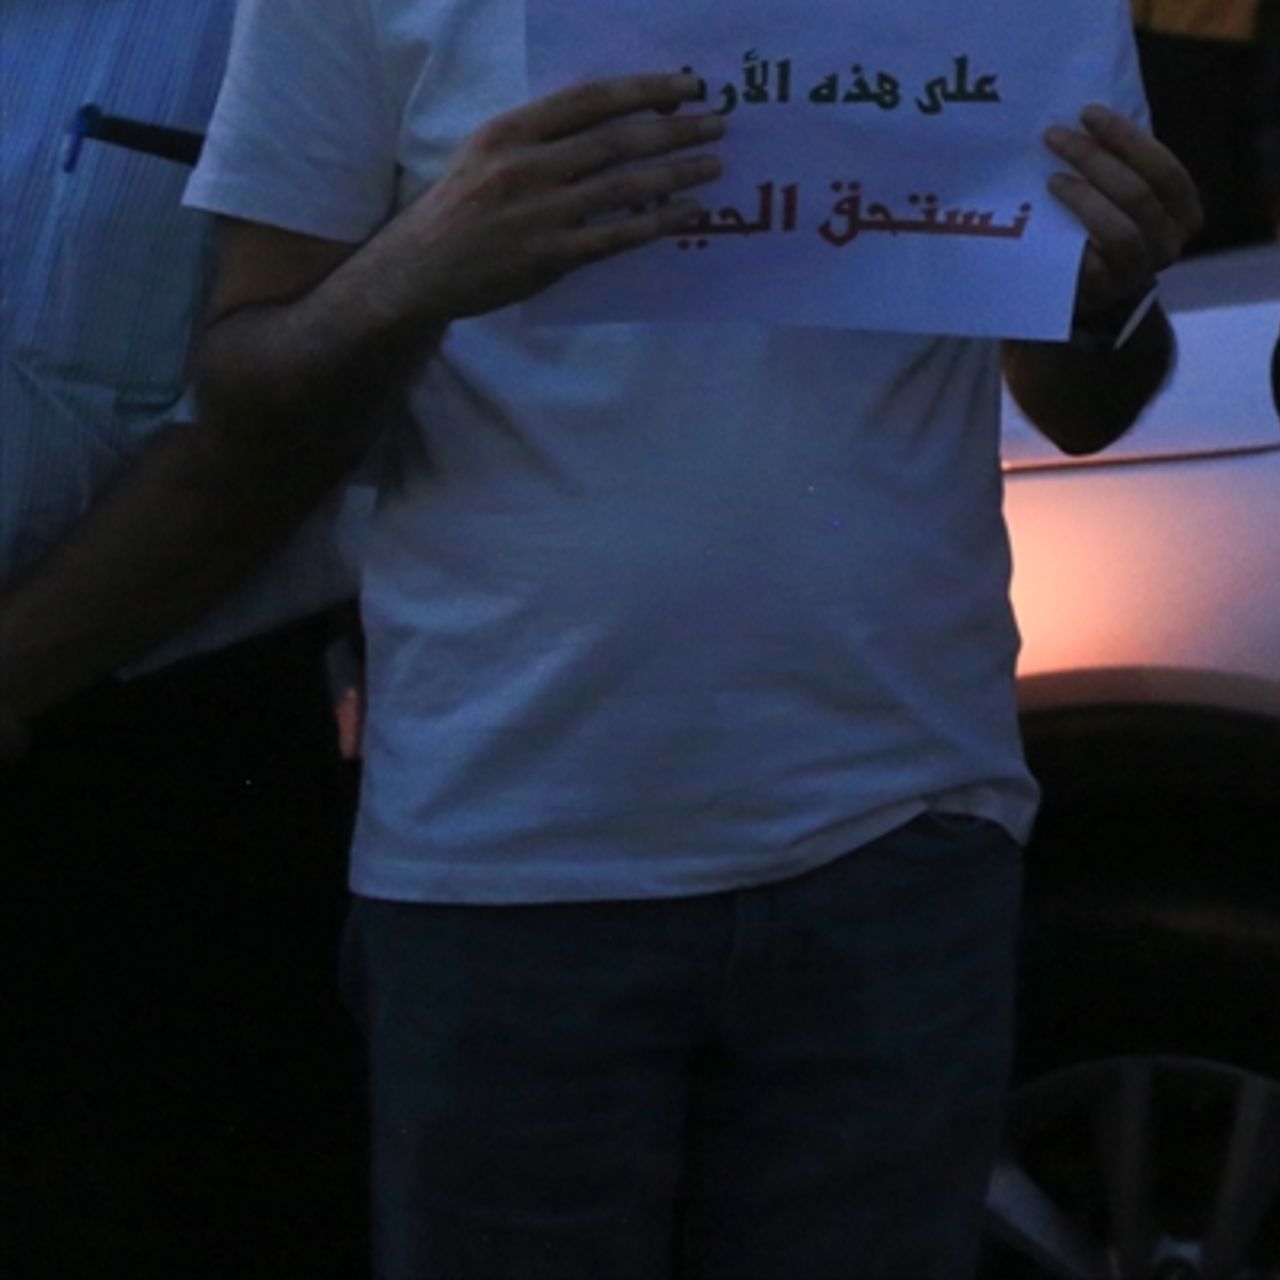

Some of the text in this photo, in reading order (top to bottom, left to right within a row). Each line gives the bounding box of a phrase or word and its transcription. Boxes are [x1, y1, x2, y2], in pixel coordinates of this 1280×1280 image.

[809, 63, 901, 110] هذه
[916, 55, 1000, 114] على
[820, 181, 1031, 247] نستحق
